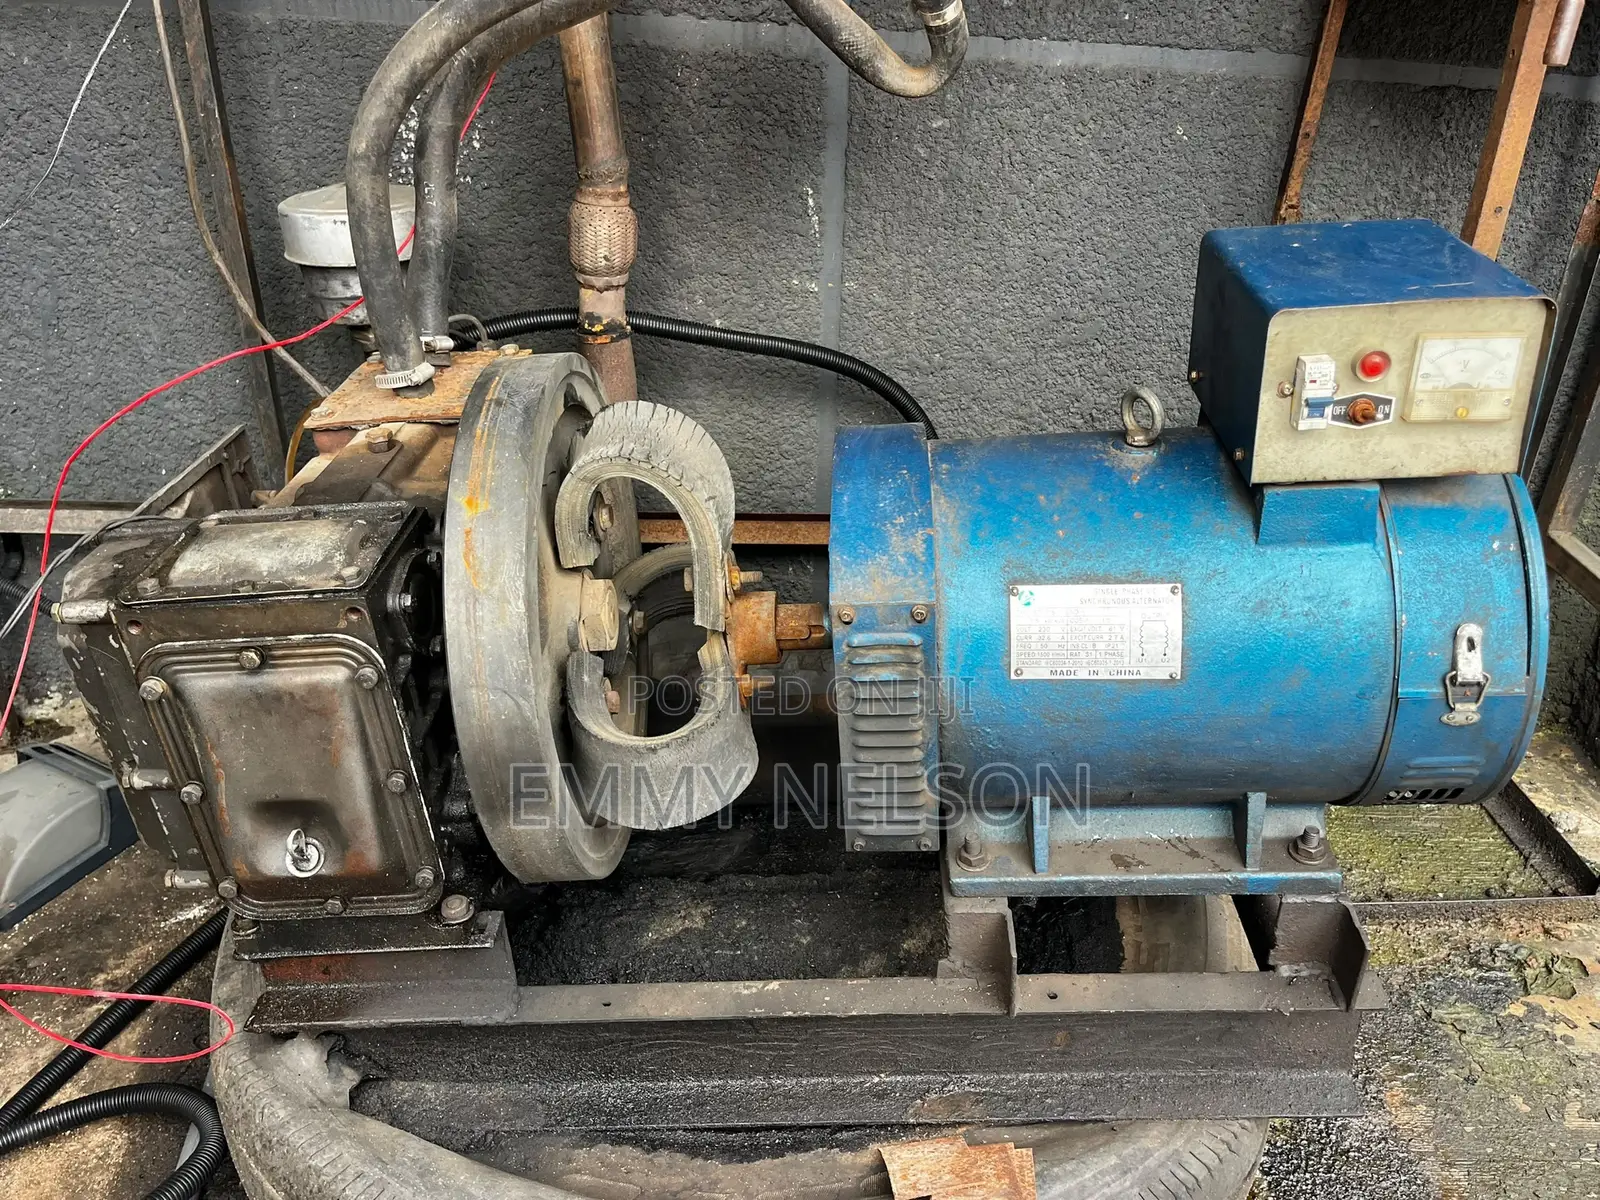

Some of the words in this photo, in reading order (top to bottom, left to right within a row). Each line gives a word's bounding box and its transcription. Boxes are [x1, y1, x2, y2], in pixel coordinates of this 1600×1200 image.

[1333, 405, 1347, 416] OFF
[1377, 404, 1391, 415] ON
[1050, 669, 1079, 677] MADE
[1088, 669, 1099, 677] IN
[1109, 669, 1142, 677] CHINA
